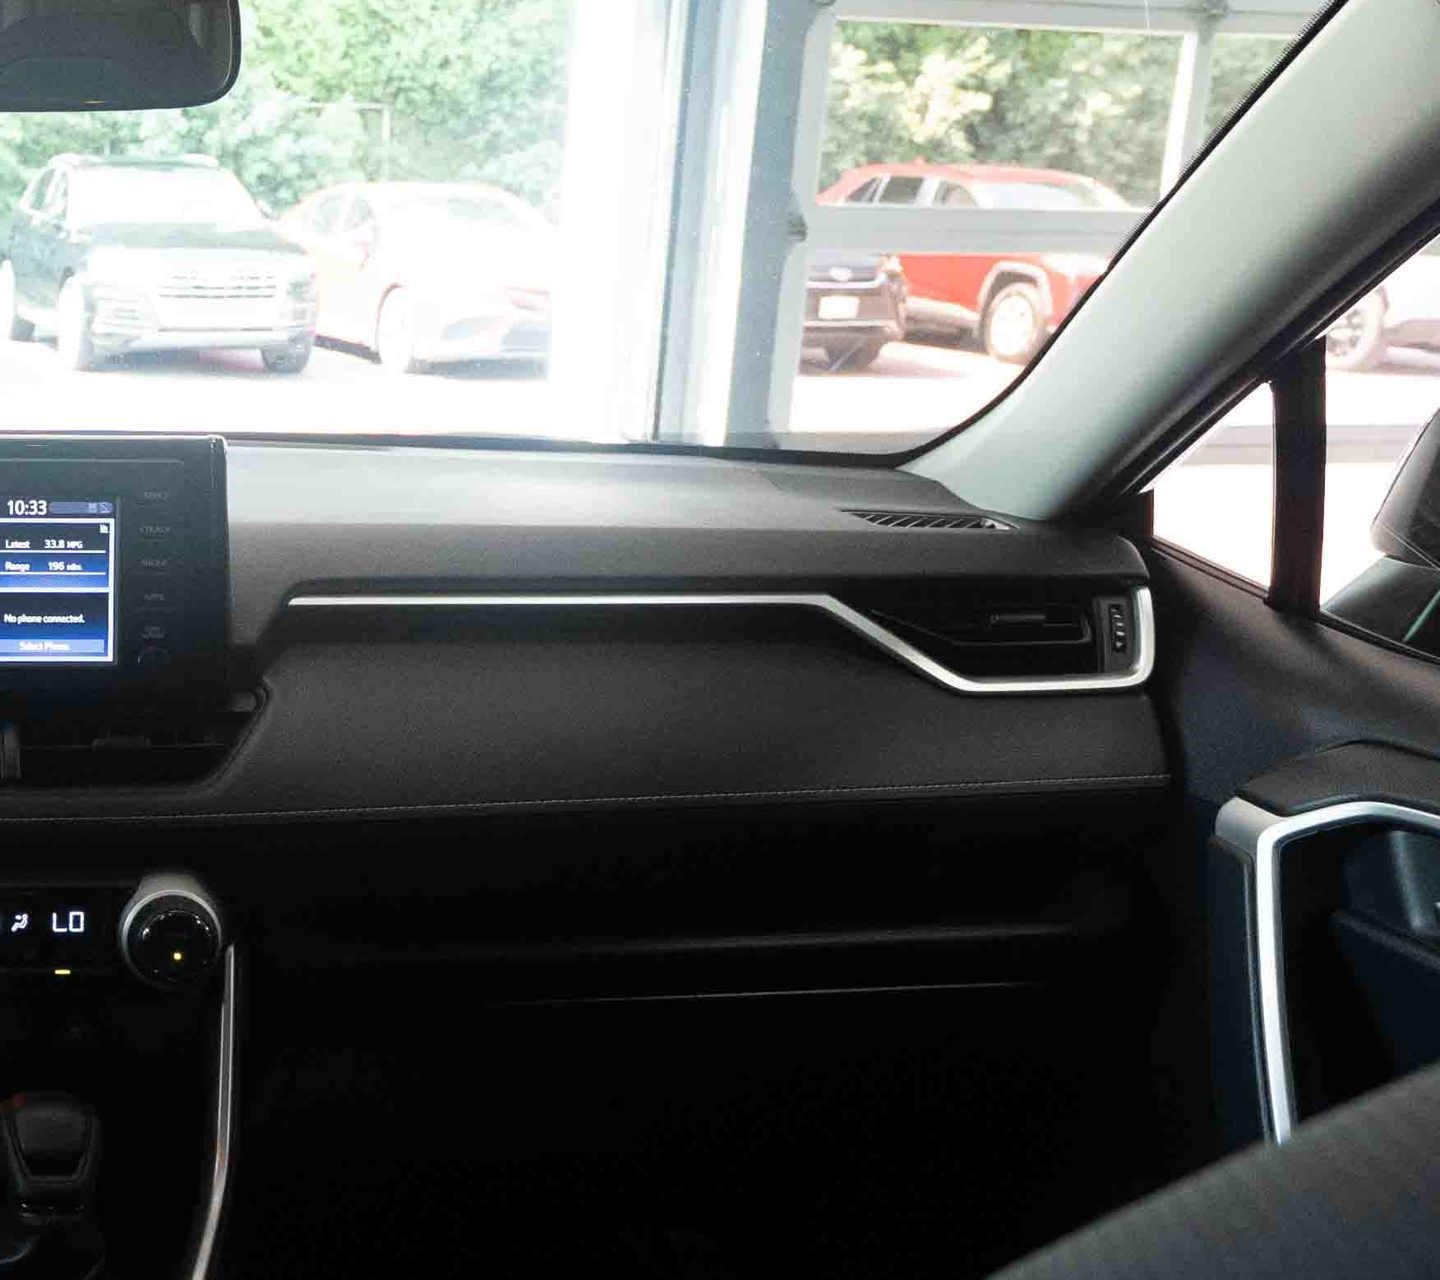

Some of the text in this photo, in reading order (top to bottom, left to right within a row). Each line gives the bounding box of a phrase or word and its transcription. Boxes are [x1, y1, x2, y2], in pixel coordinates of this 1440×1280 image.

[7, 500, 48, 516] 10:33
[3, 613, 85, 625] No phone connected.
[52, 911, 85, 934] LO
